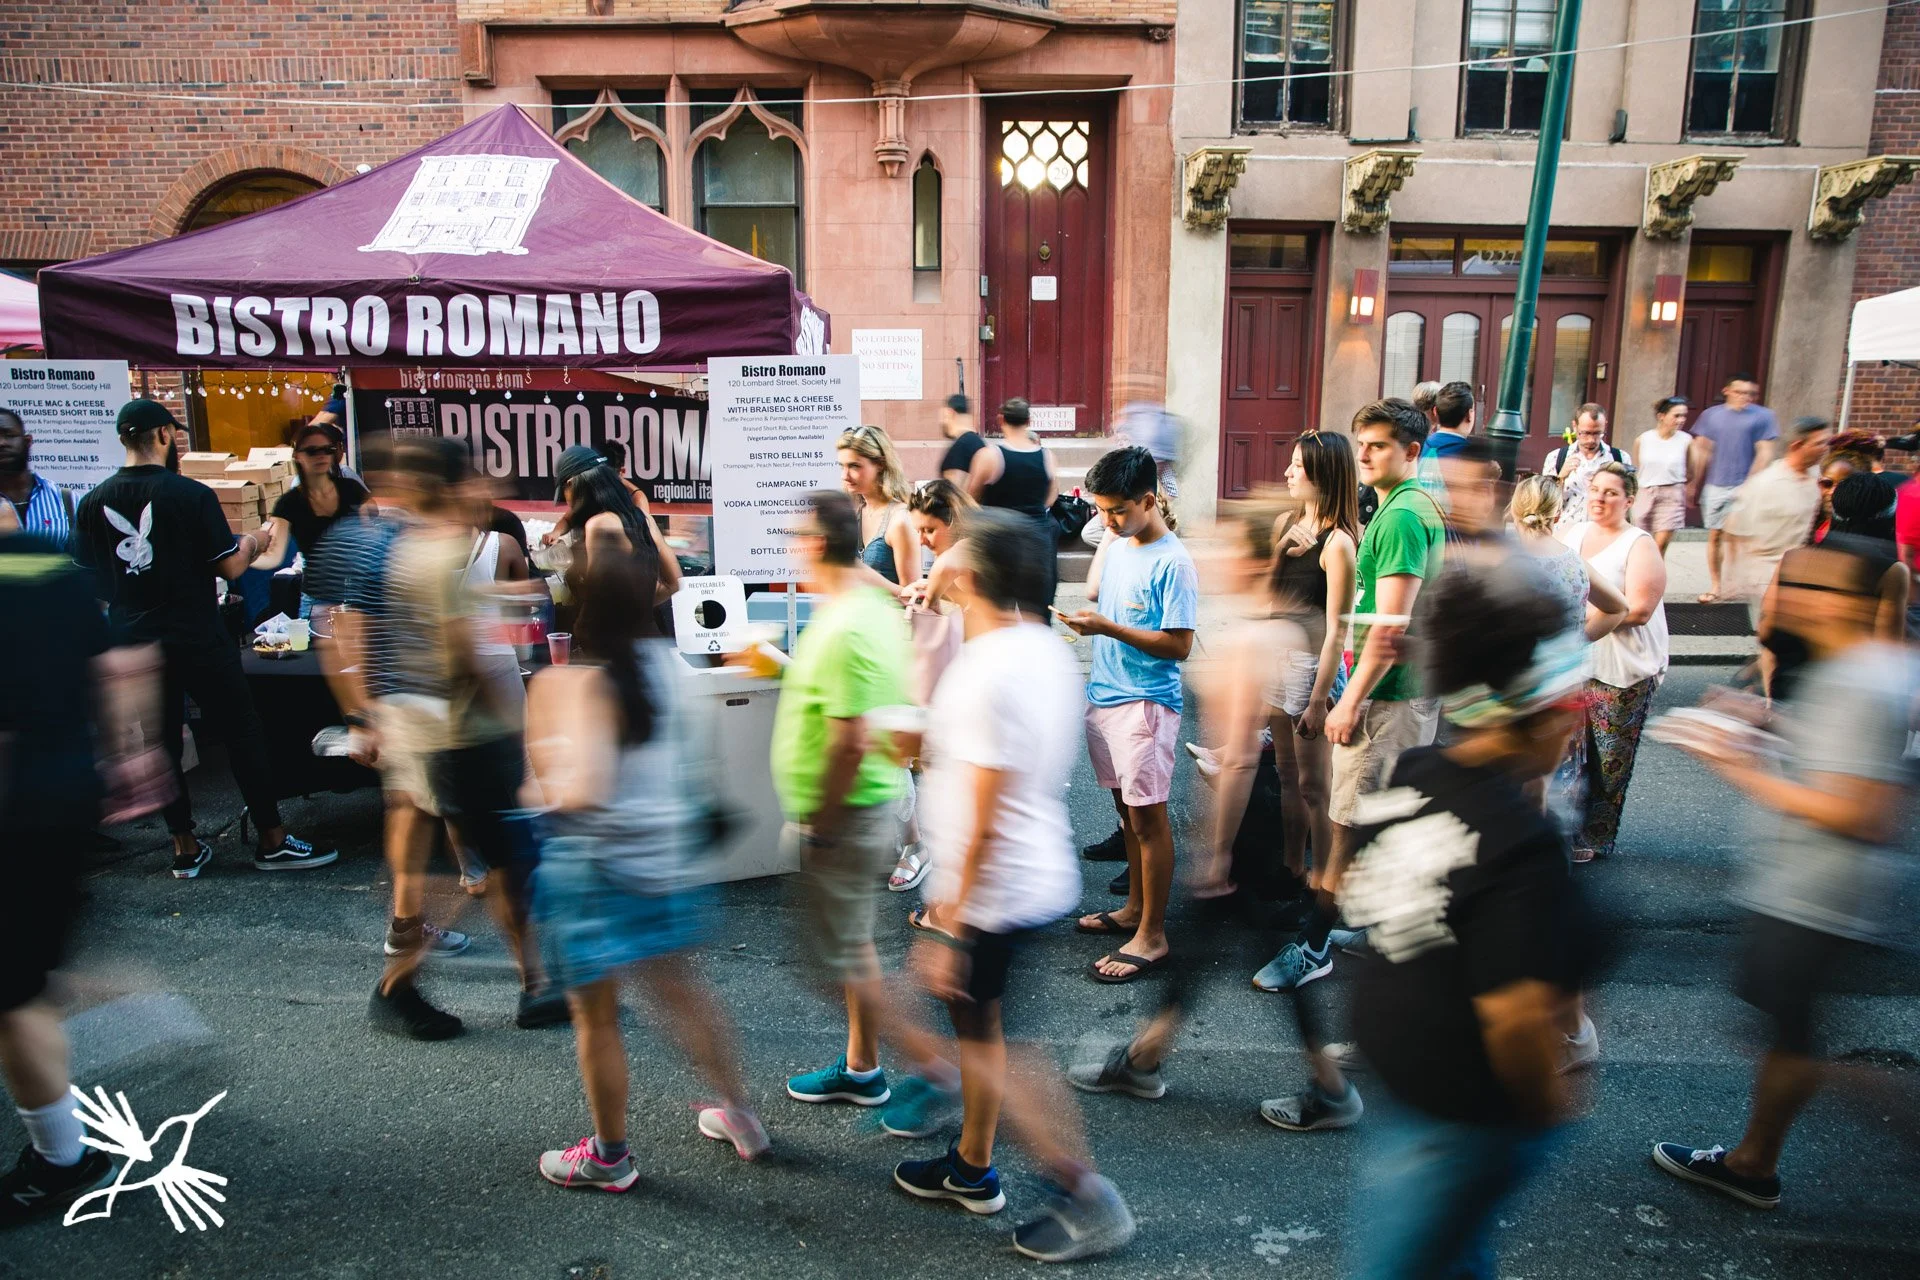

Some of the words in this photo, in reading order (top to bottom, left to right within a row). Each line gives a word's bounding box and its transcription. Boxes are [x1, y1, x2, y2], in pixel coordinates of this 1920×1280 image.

[1054, 167, 1069, 180] 29
[171, 294, 390, 357] BISTRO
[406, 290, 661, 357] ROMANO
[871, 335, 920, 343] LOITERING
[862, 362, 875, 370] NO
[877, 362, 913, 370] SITTING
[11, 368, 45, 380] Bistro
[47, 368, 95, 380] Romano
[741, 365, 776, 377] Bistro
[779, 365, 826, 377] Romano
[400, 368, 524, 389] bistroromano.com
[742, 379, 775, 387] Lombard
[801, 378, 828, 387] Society
[72, 383, 98, 391] Society
[801, 395, 834, 403] CHEESE
[728, 406, 748, 414] WITH
[750, 405, 786, 413] BRAISED
[833, 404, 843, 412] $5
[1033, 411, 1053, 419] NOT
[1048, 420, 1074, 428] STEPS
[440, 403, 592, 478] BISTRO
[749, 452, 779, 460] BISTRO
[756, 480, 807, 488] CHAMPAGNE
[653, 480, 697, 503] regional
[723, 500, 752, 508] VODKA
[753, 499, 806, 507] LIMONCELLO
[730, 568, 774, 577] Celebrating
[788, 568, 801, 576] yrs
[688, 581, 726, 589] RECYCLABLES
